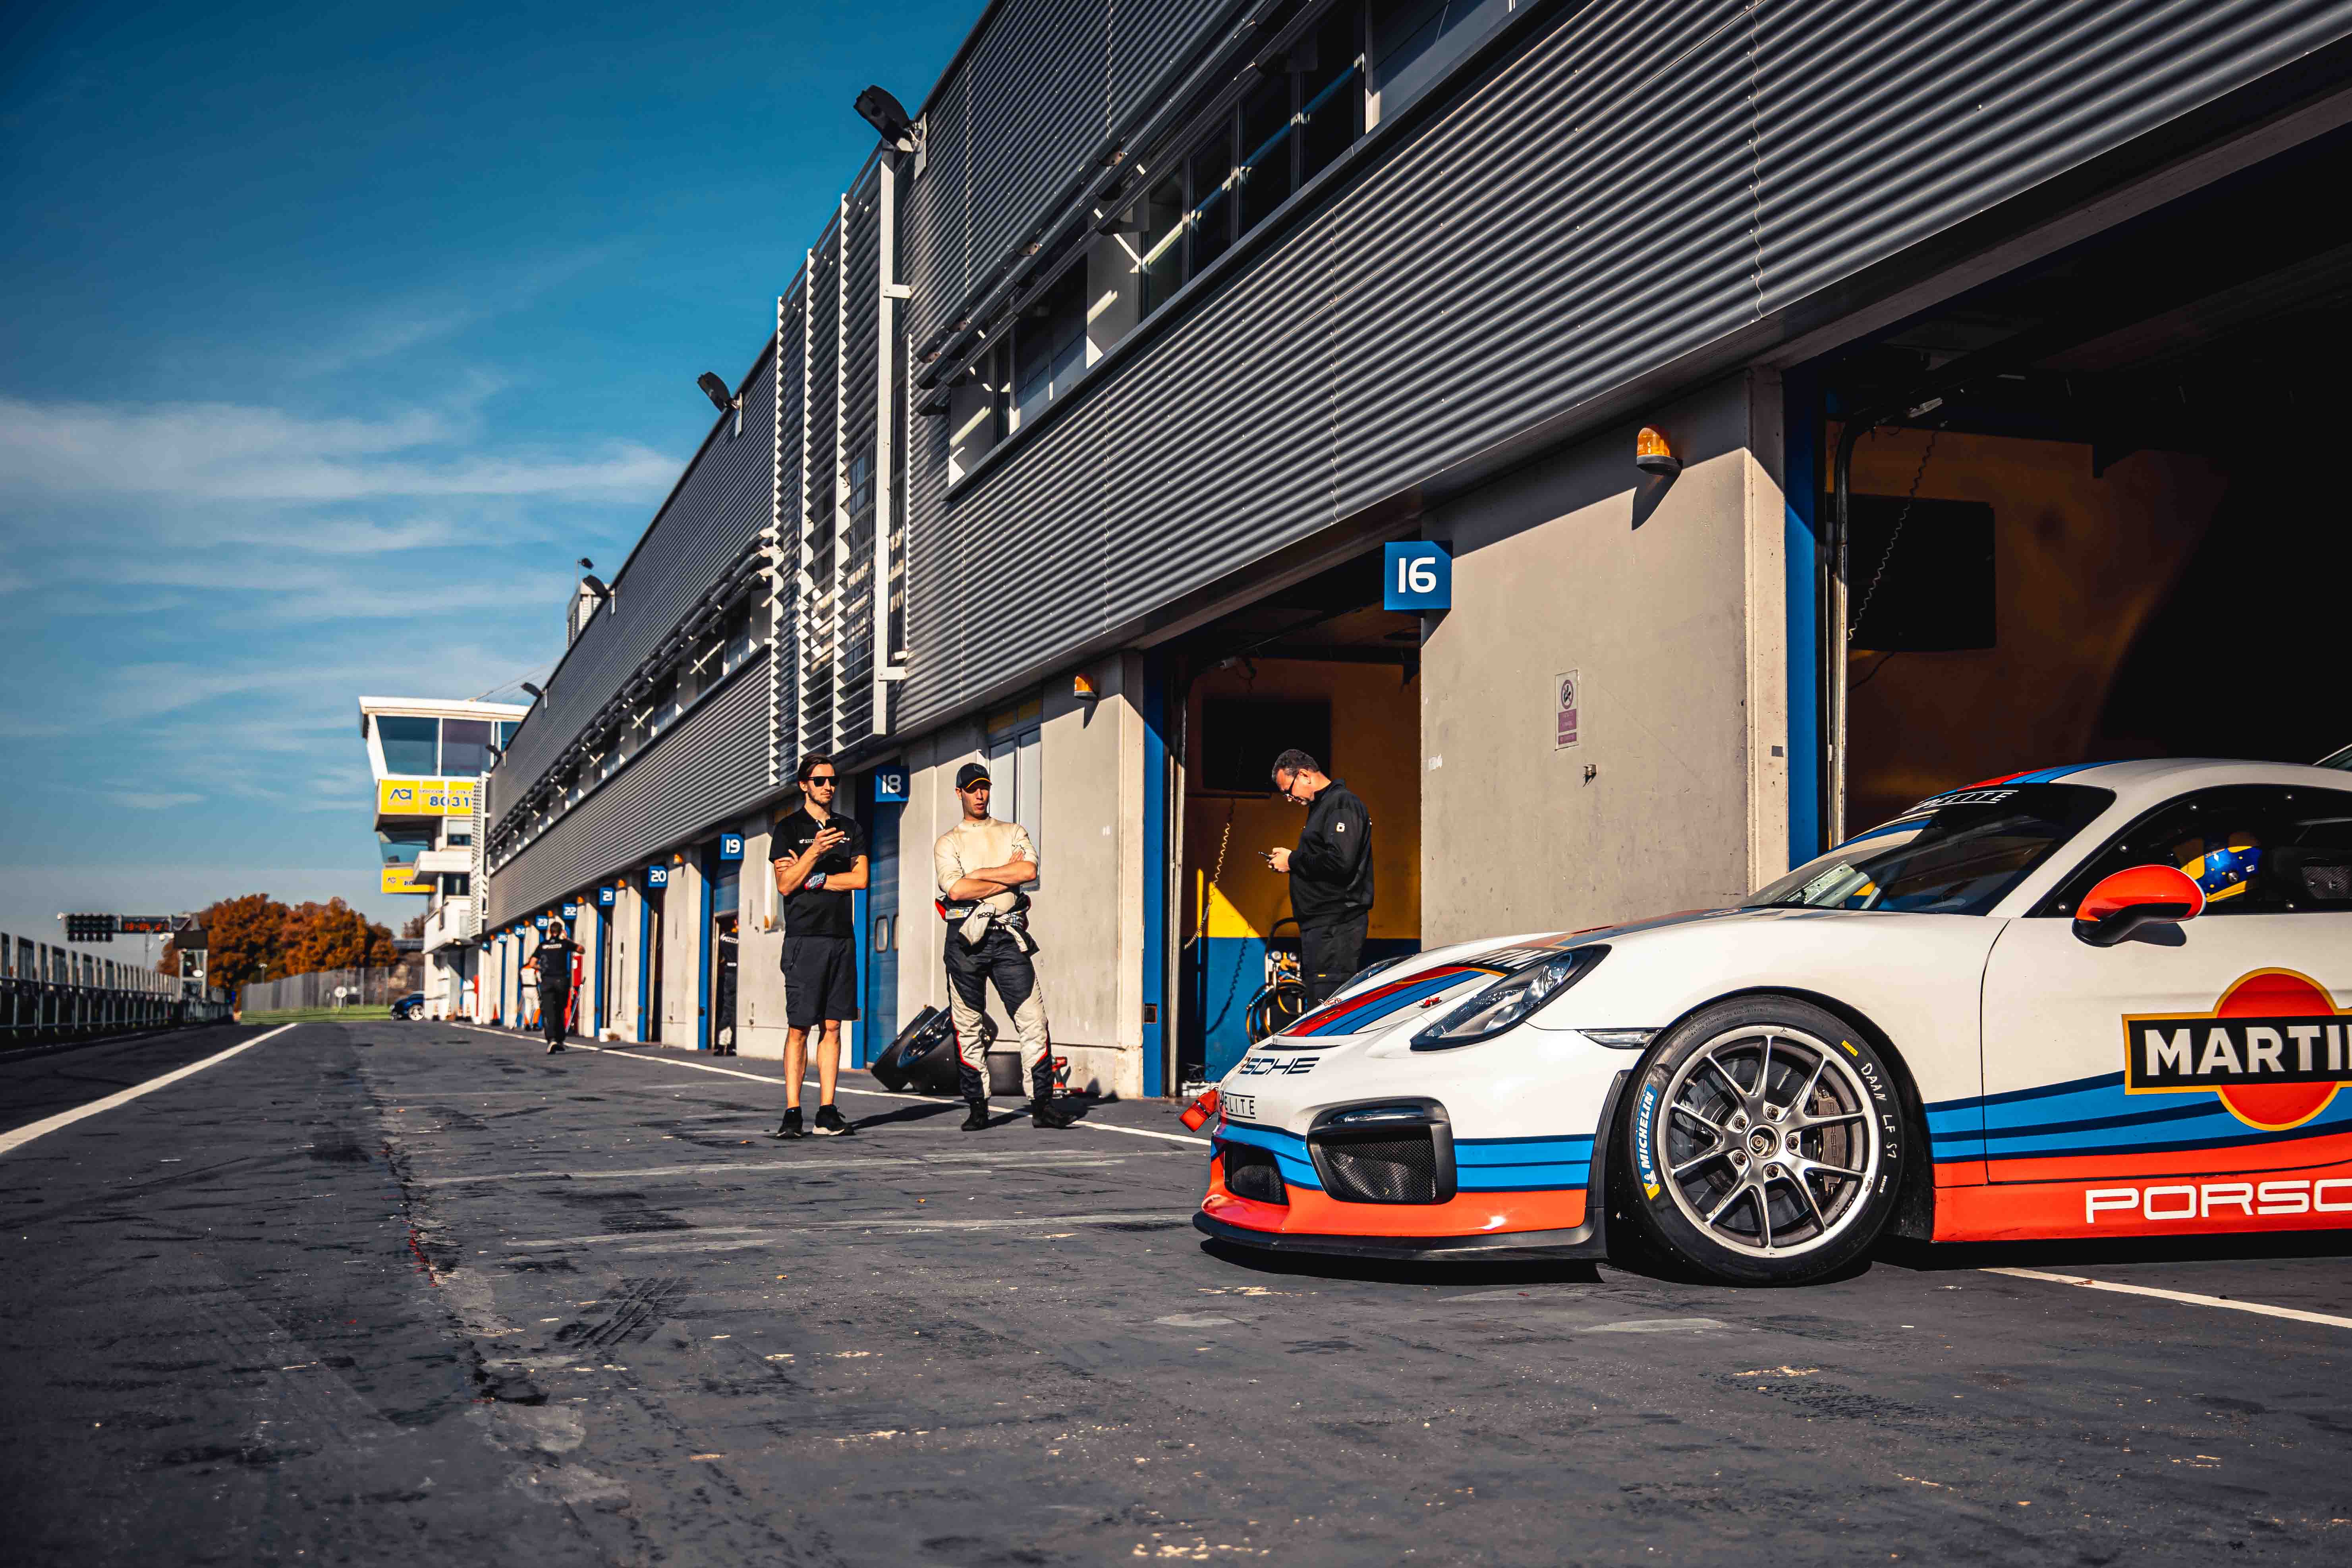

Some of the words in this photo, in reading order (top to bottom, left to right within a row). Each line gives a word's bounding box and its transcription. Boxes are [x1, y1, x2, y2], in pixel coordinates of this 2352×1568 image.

[1398, 556, 1437, 593] 16
[882, 774, 902, 794] 18
[726, 839, 741, 854] 19
[651, 870, 666, 882] 20
[602, 891, 612, 901] 21
[564, 906, 576, 916] 22
[2145, 1025, 2352, 1076] MARTI
[1861, 1062, 1887, 1101] DAAN
[1883, 1115, 1895, 1133] LF
[1639, 1091, 1654, 1169] MICHELIN
